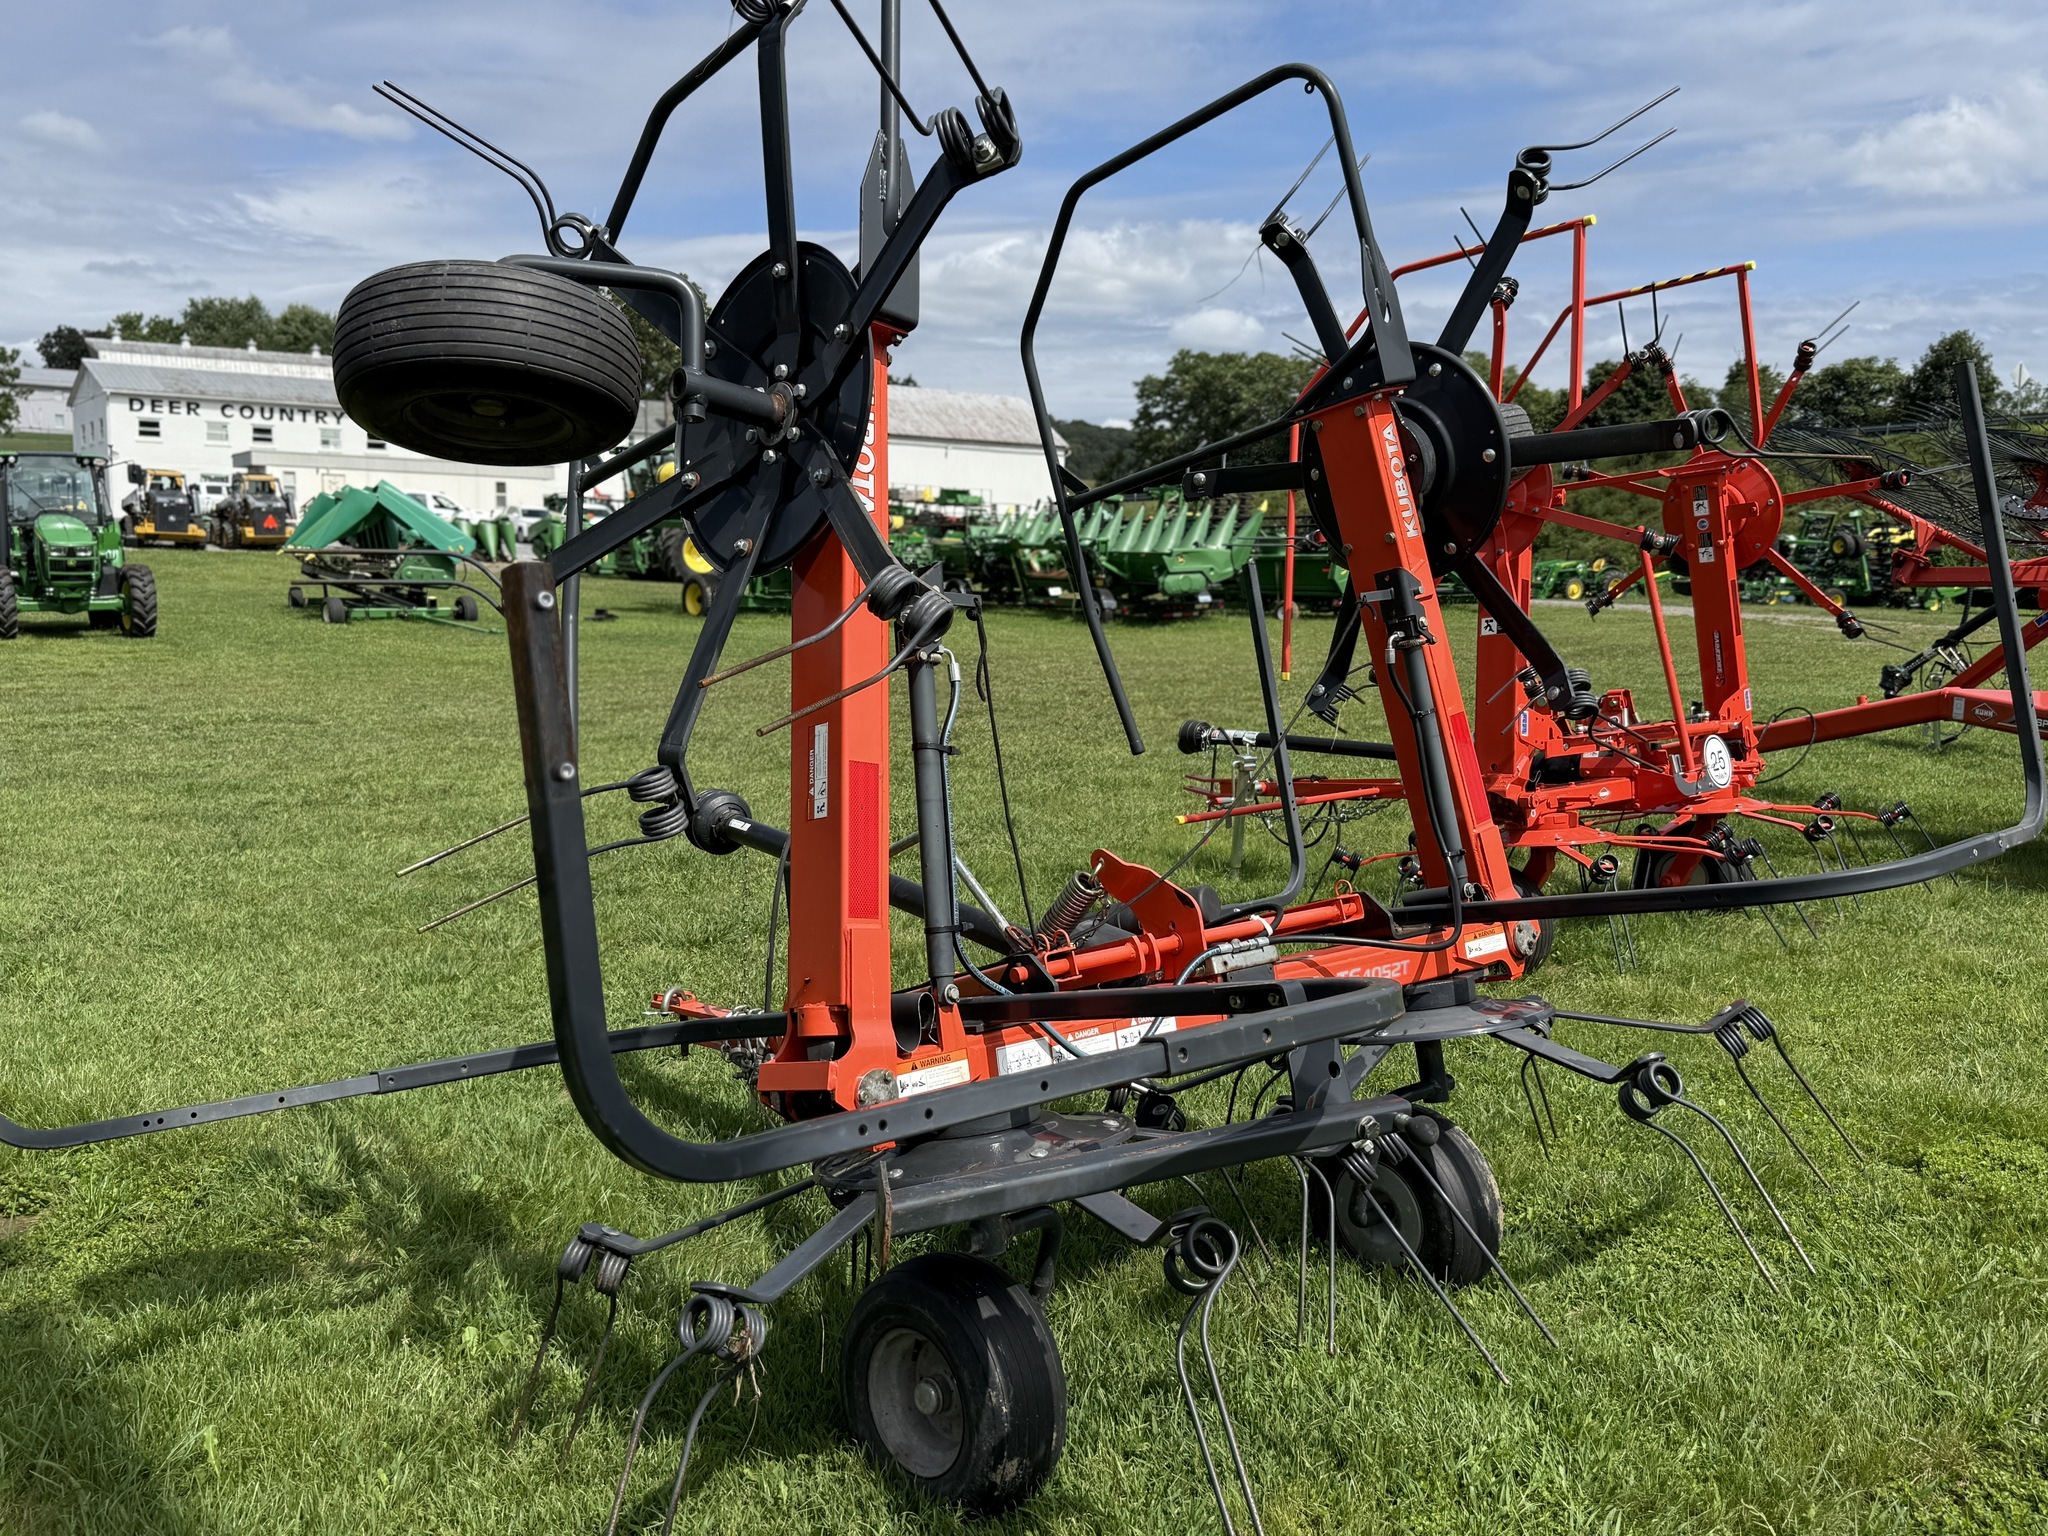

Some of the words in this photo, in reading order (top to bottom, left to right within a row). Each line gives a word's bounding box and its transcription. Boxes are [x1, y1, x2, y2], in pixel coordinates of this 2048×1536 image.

[128, 397, 200, 416] DEER
[220, 403, 346, 425] COUNTRY
[1382, 421, 1420, 538] KUBOTA
[1710, 750, 1726, 770] 25
[1074, 1027, 1100, 1040] DANGER
[920, 1054, 952, 1068] WARNING
